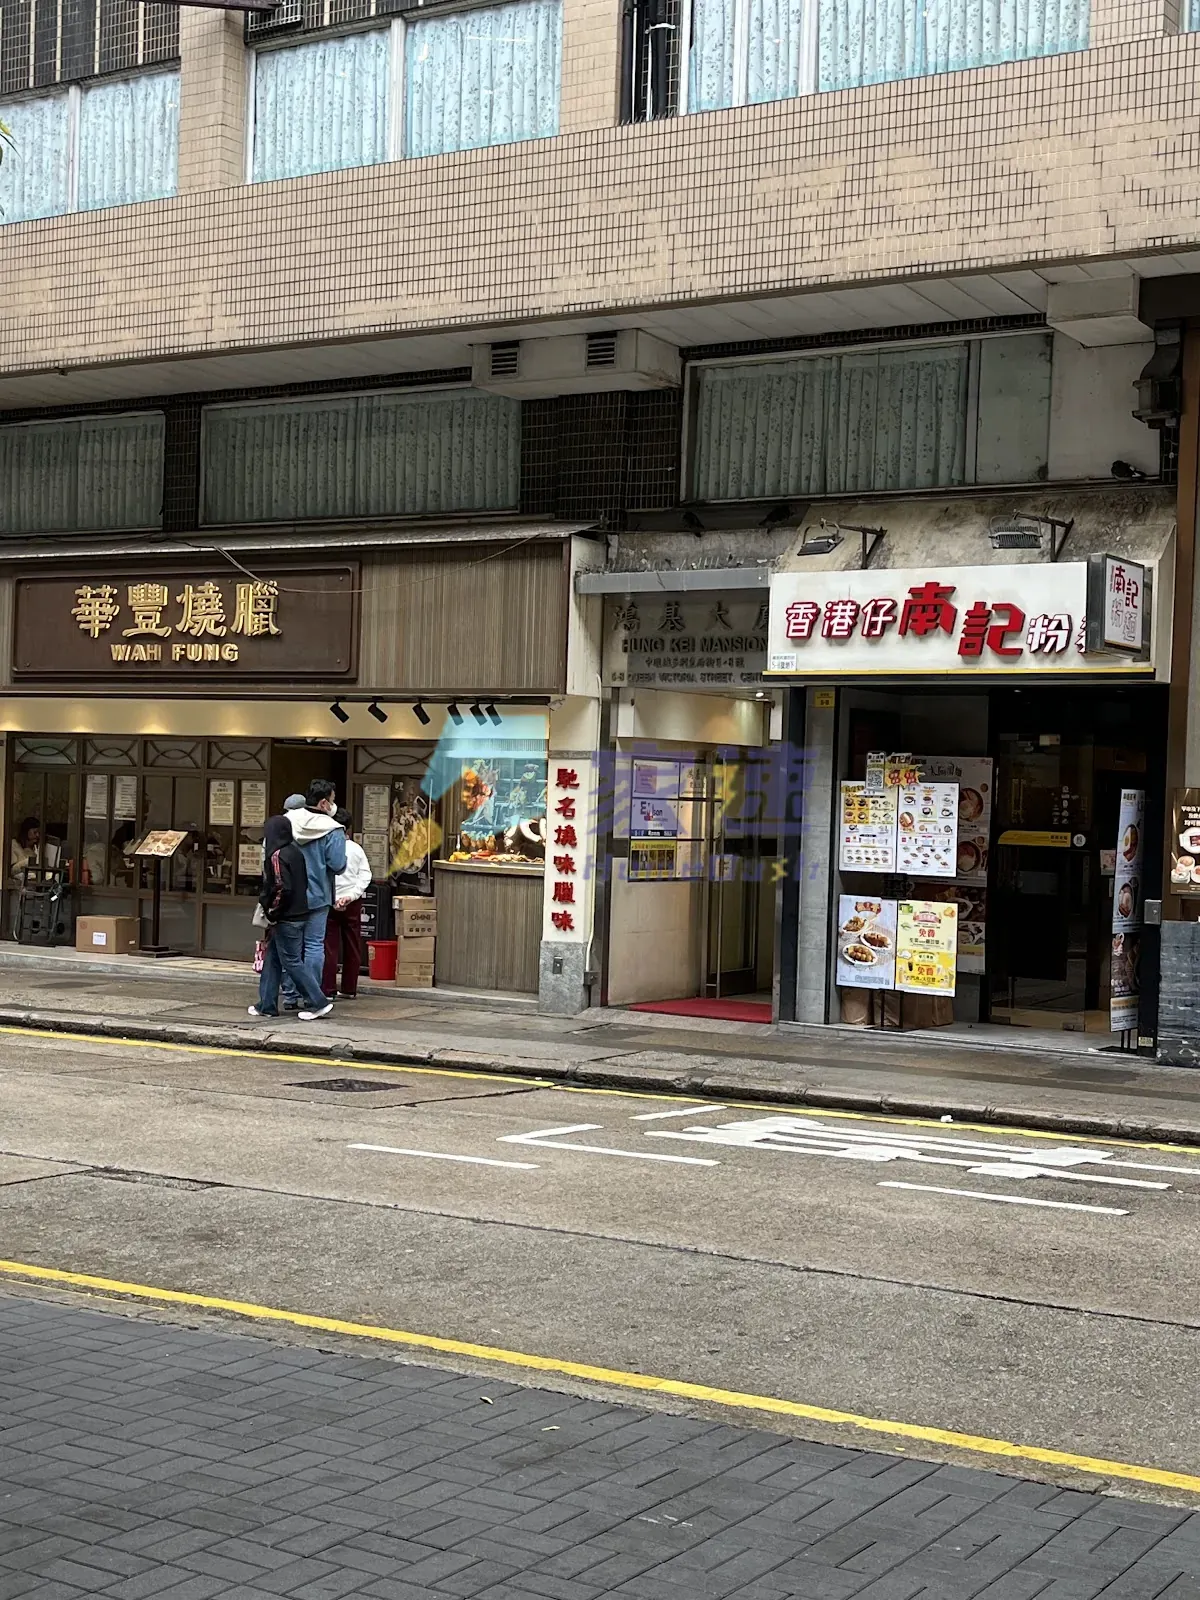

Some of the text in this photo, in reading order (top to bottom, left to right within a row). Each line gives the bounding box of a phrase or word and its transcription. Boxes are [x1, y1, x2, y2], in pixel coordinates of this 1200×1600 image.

[110, 643, 239, 662] WAH FUNG
[621, 637, 664, 653] HUNG
[670, 637, 695, 653] KEI
[551, 768, 580, 932] 馳名燒味臘味
